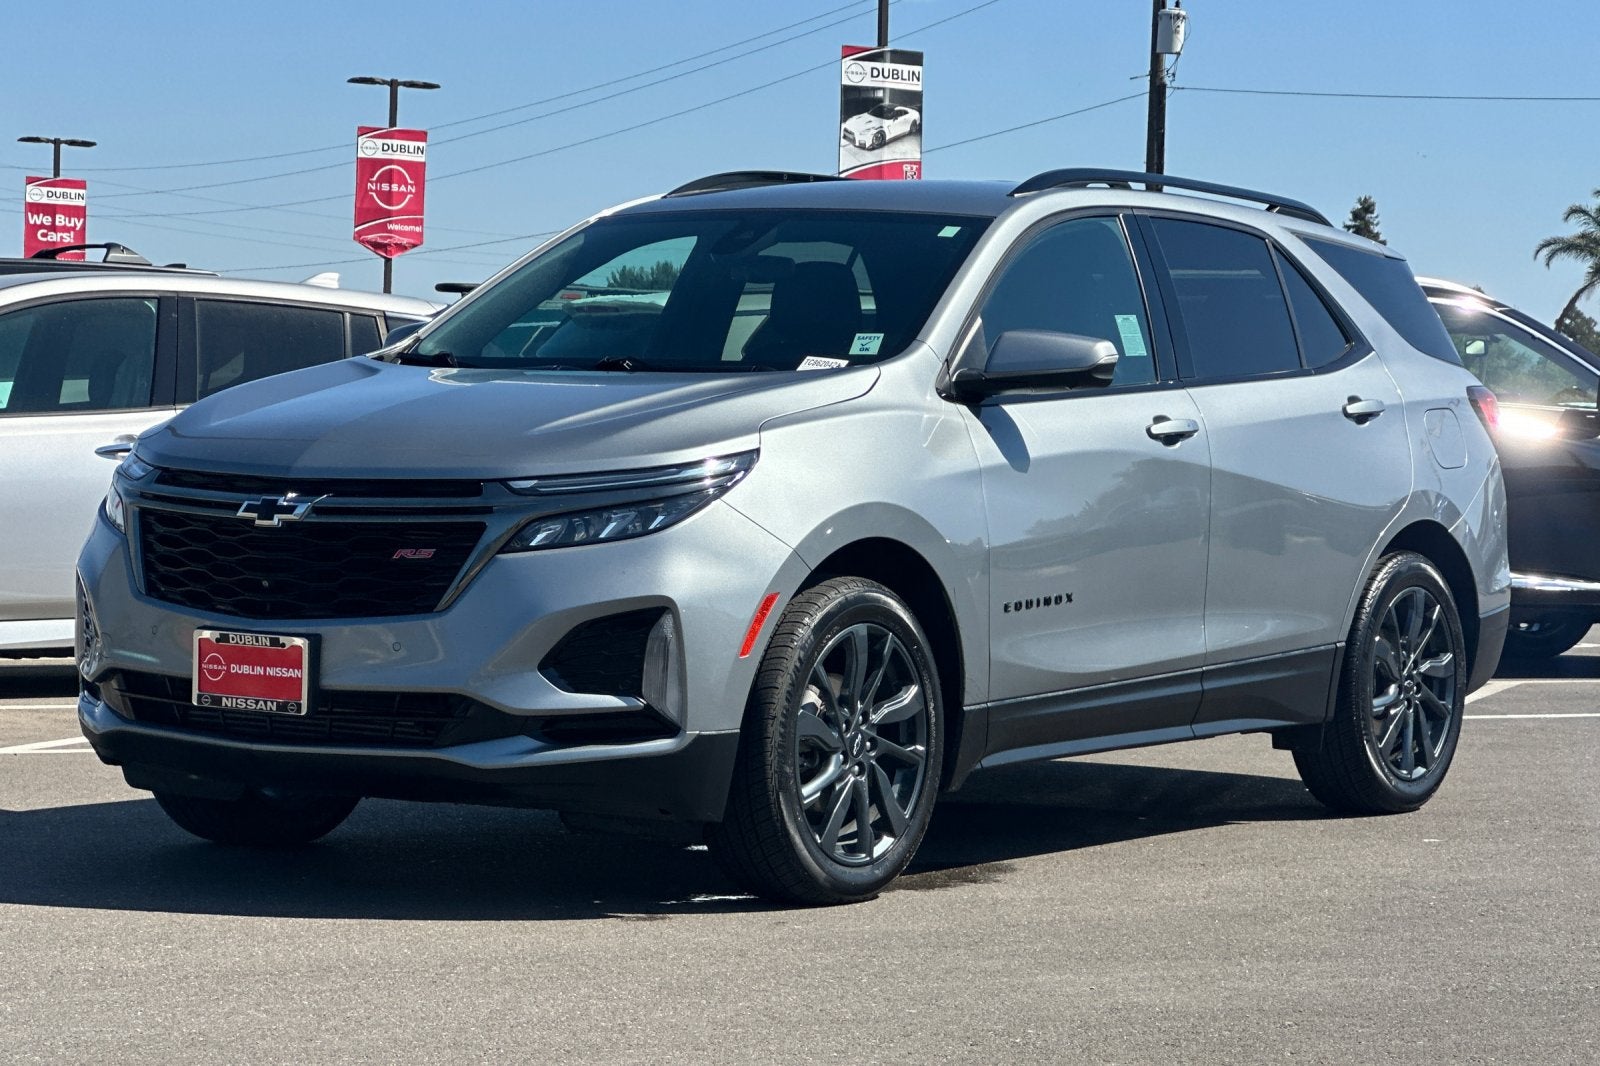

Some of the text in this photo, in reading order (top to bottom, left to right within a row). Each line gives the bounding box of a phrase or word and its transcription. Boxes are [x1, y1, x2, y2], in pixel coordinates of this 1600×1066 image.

[870, 66, 921, 83] DUBLIN
[381, 142, 425, 156] DUBLIN
[367, 182, 416, 194] NISSAN
[46, 190, 85, 201] DUBLIN
[27, 211, 84, 231] We Buy
[386, 223, 422, 232] Welcome!
[36, 229, 75, 243] Cars!
[393, 548, 437, 559] RS
[1003, 592, 1073, 613] EQUINOX
[229, 634, 270, 647] DUBLIN
[201, 663, 227, 671] NISSAN
[230, 663, 302, 678] DUBLIN NISSAN
[221, 697, 277, 711] NISSAN
